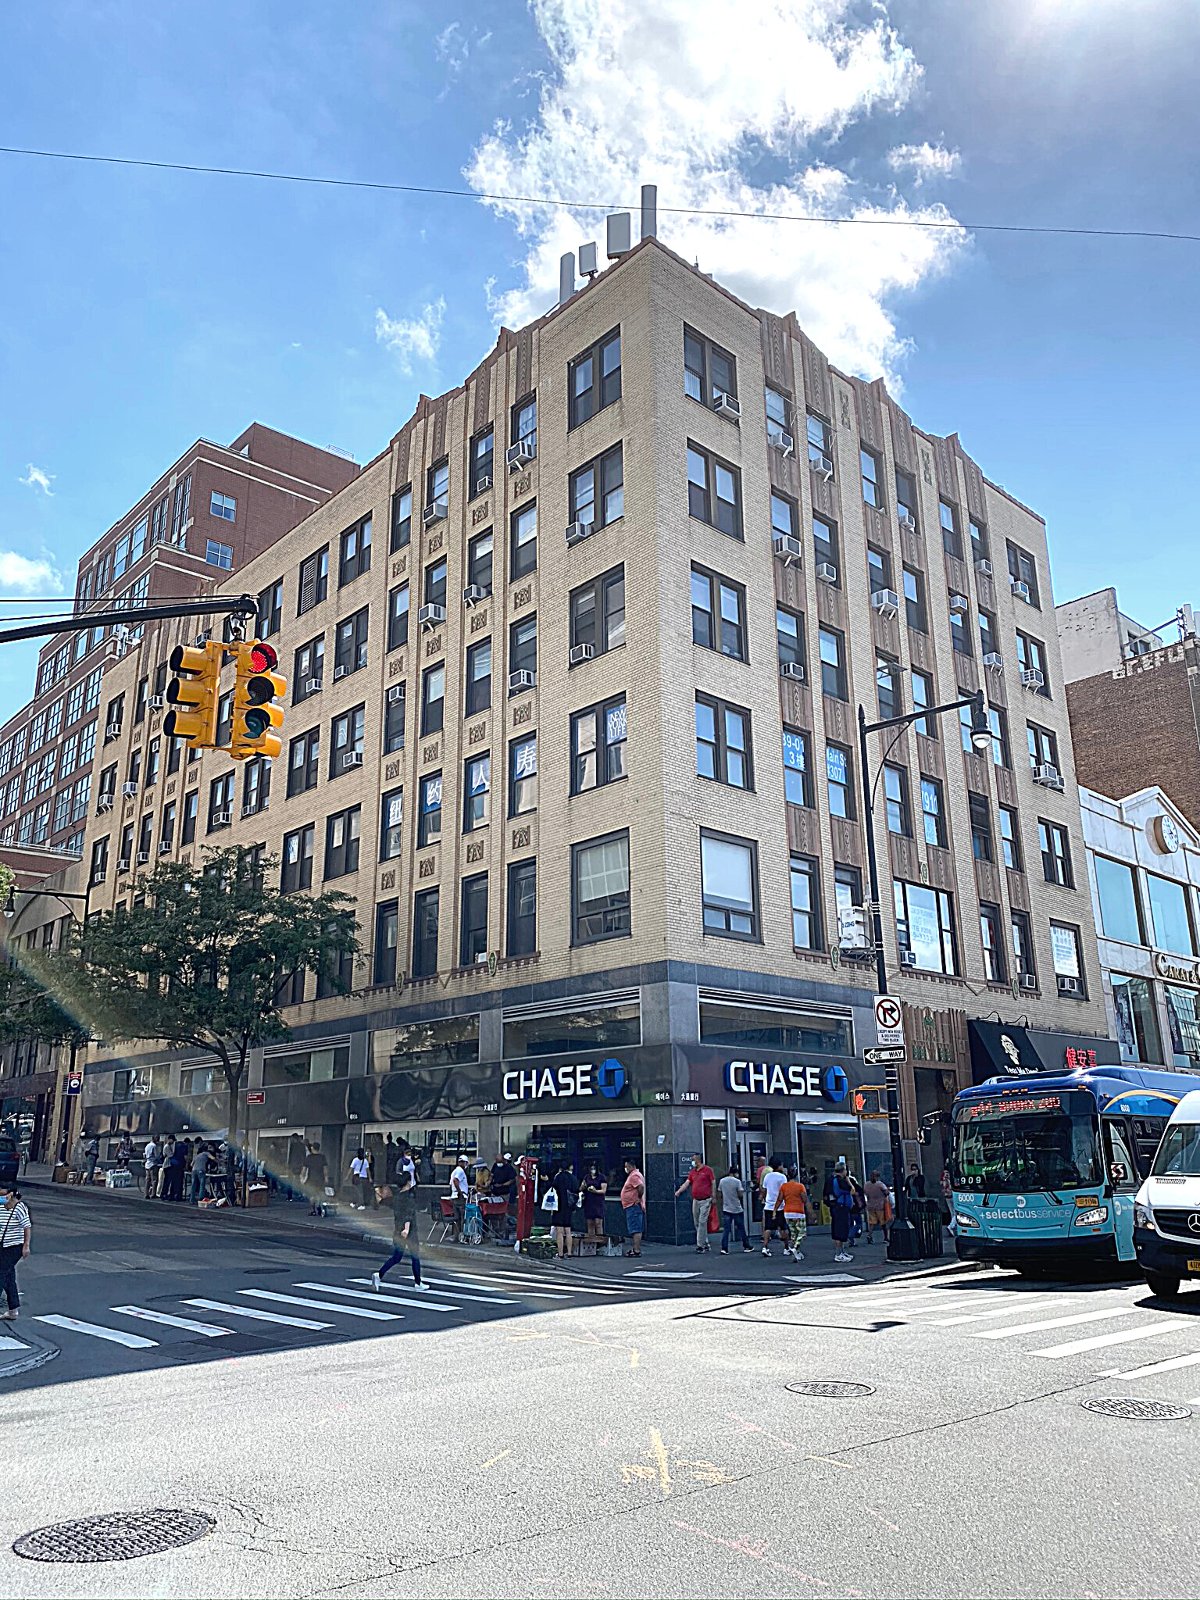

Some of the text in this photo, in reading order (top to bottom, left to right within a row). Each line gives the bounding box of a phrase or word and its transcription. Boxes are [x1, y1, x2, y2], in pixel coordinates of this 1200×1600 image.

[611, 709, 627, 721] NEW
[608, 717, 628, 730] YORK
[610, 725, 627, 738] LIFE
[783, 732, 805, 752] 39-01
[869, 1052, 882, 1060] ONE
[503, 1064, 593, 1100] CHASE
[729, 1061, 823, 1097] CHASE
[958, 1194, 975, 1202] 6000
